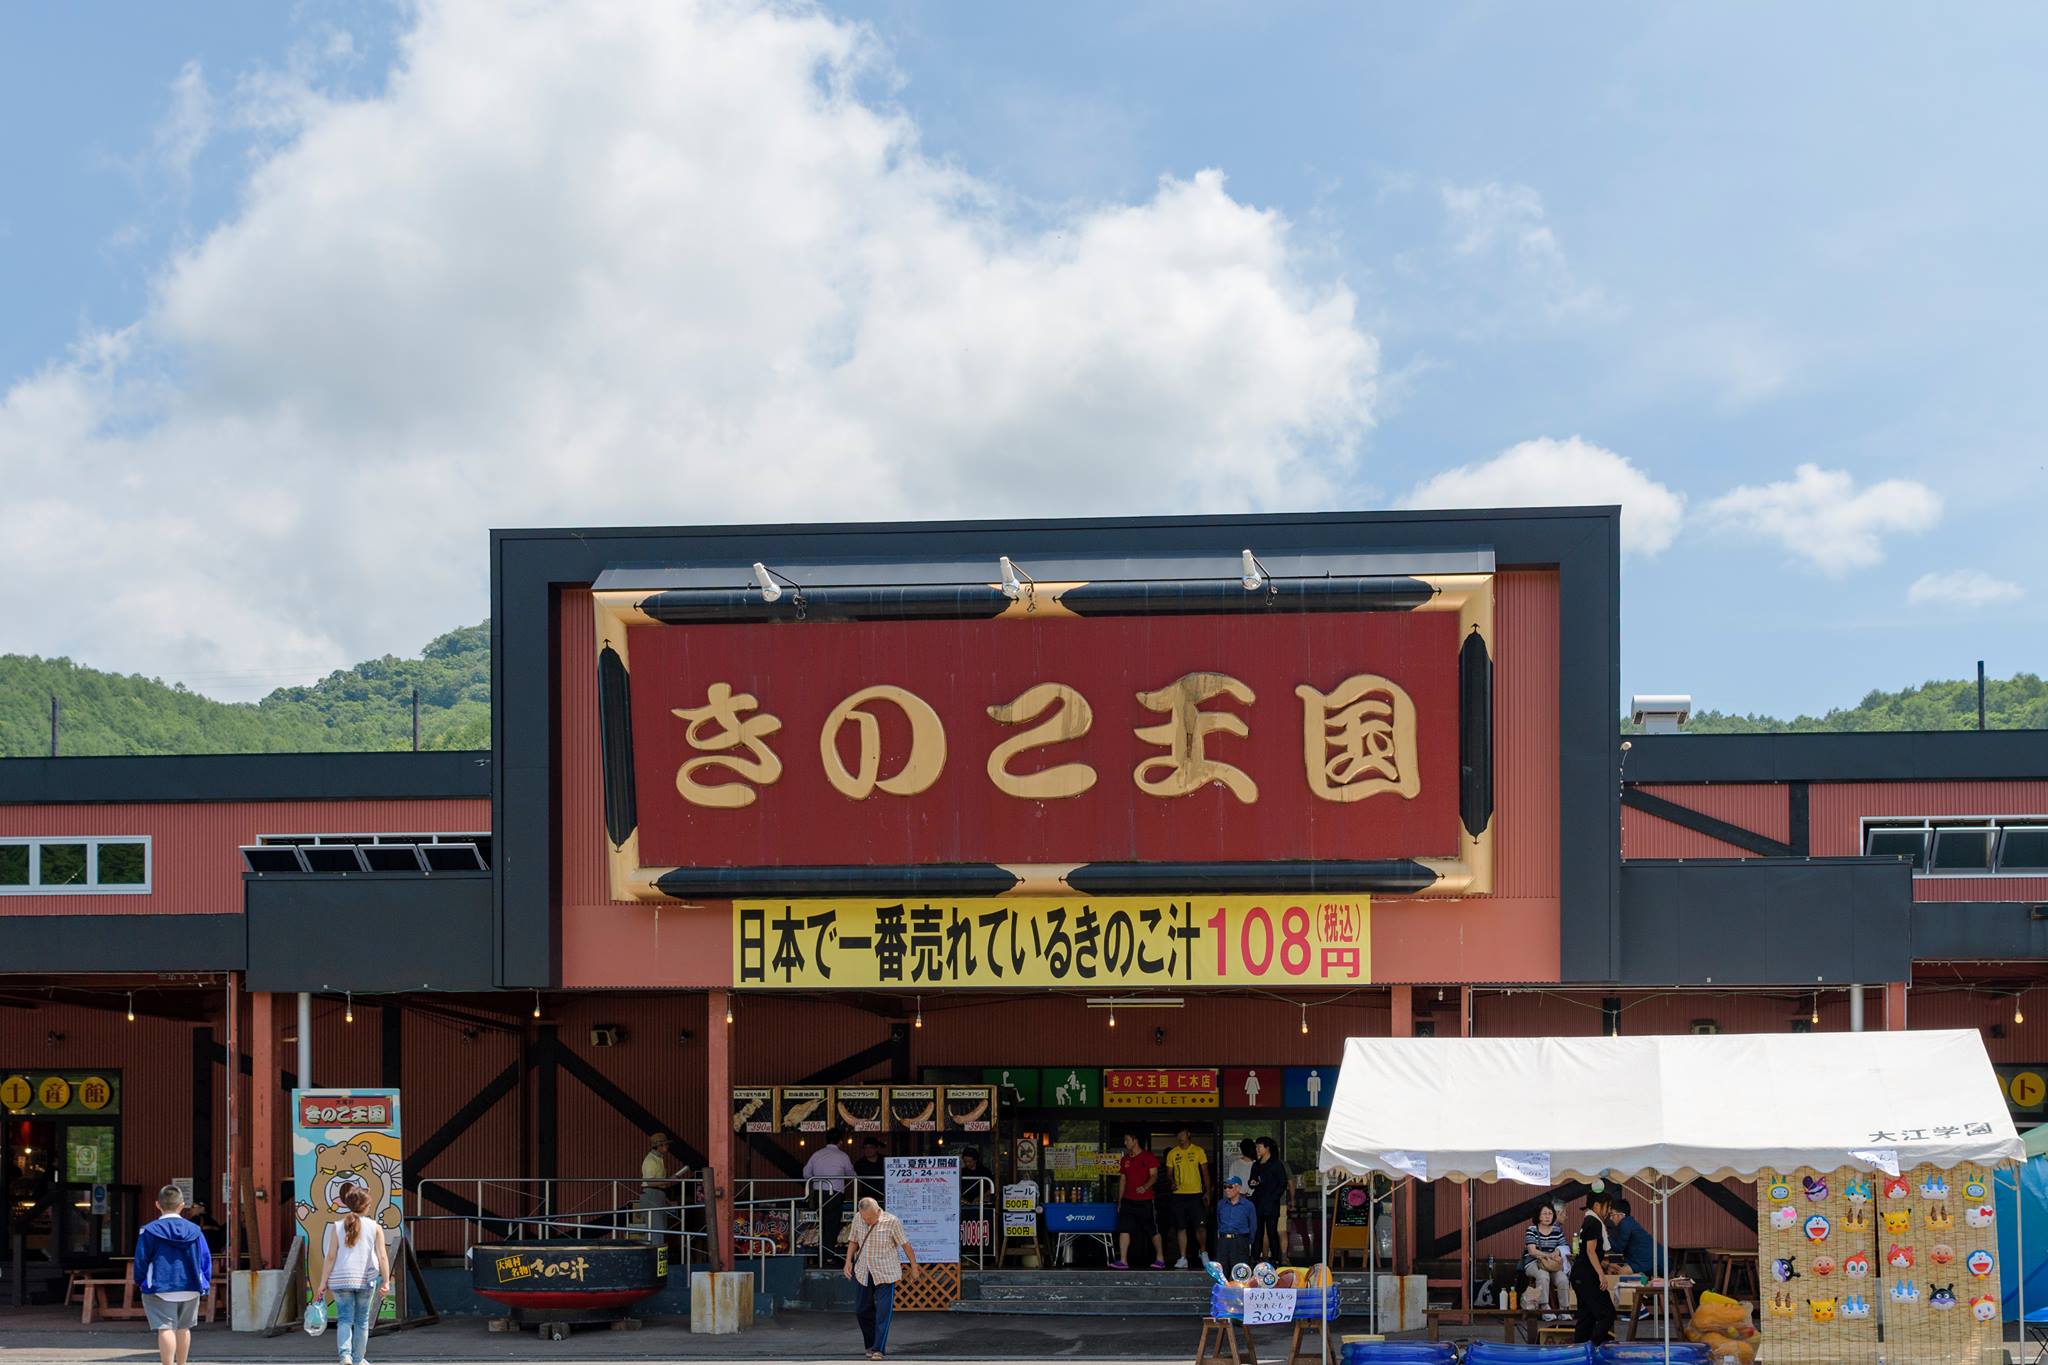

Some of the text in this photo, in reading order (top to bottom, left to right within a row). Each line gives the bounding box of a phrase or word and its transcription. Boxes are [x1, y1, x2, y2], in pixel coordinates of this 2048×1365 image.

[672, 672, 1421, 807] きのこ王国
[1112, 1074, 1211, 1088] きのこ王国 仁木店
[1136, 1096, 1187, 1104] TOILET
[304, 1105, 386, 1123] きのこ王国
[1869, 1122, 1993, 1142] 大江学園
[908, 1158, 958, 1169] 夏祭り開催
[1004, 1187, 1035, 1196] ビール
[1005, 1199, 1029, 1209] 500円
[1004, 1214, 1035, 1222] ビール
[1006, 1226, 1030, 1235] 500円
[531, 1256, 590, 1282] きのこ汁
[1252, 1310, 1291, 1323] 300円
